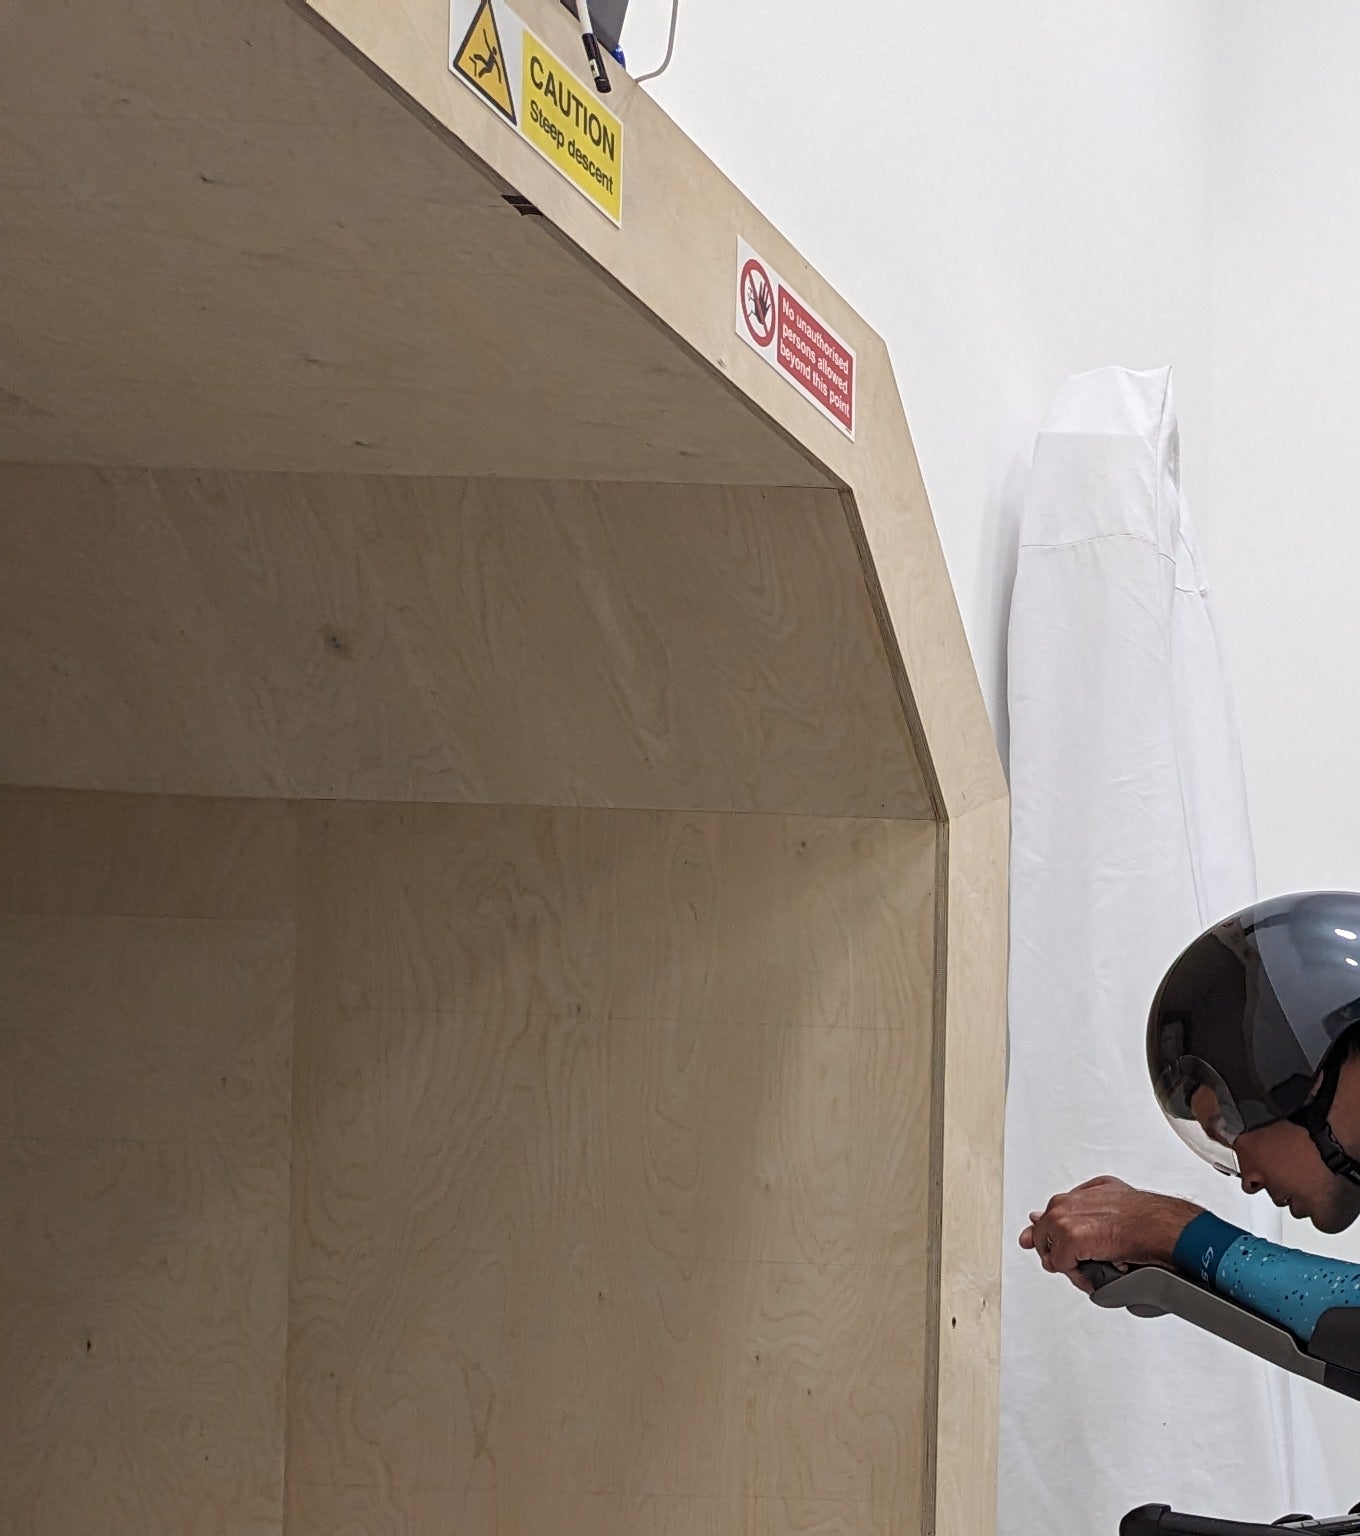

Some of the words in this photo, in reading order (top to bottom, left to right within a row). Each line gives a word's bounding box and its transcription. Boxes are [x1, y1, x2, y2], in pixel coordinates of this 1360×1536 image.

[529, 99, 565, 149] Steep
[567, 138, 614, 195] descent
[530, 55, 615, 162] CAUTION
[782, 297, 795, 321] No
[796, 314, 849, 376] unauthorised
[782, 322, 816, 364] persons
[817, 357, 848, 395] allowed
[780, 338, 812, 380] beyond
[812, 370, 828, 398] this
[829, 389, 850, 419] point
